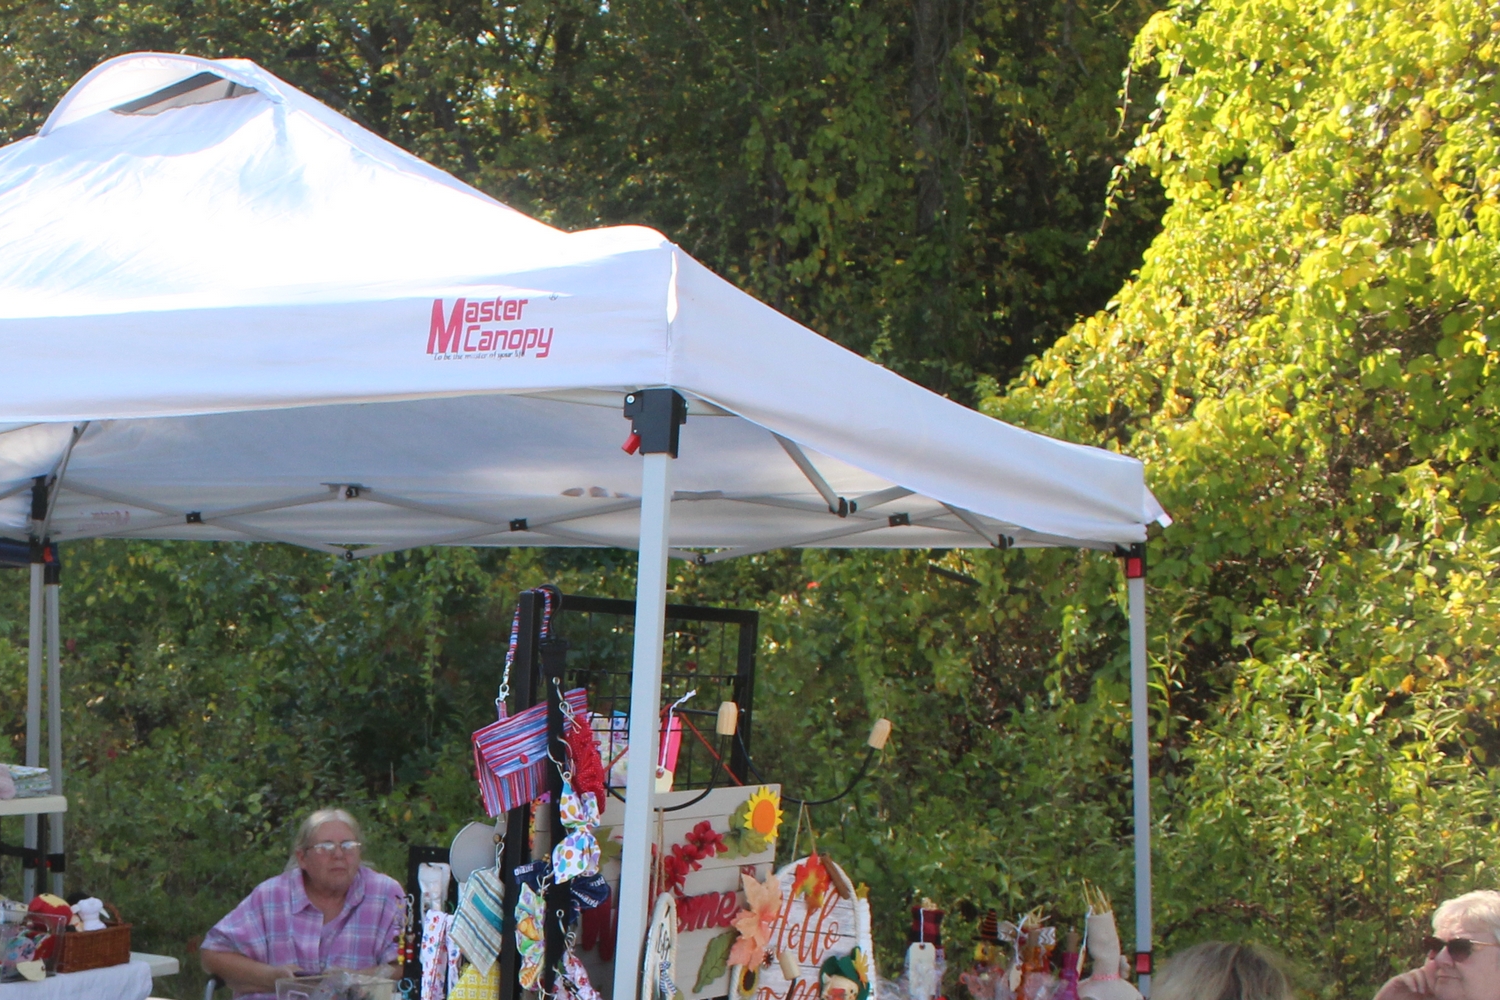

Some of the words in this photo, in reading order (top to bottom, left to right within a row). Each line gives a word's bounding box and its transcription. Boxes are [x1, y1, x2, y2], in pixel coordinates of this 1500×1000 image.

[426, 296, 528, 353] Master
[464, 324, 554, 359] Canopy
[767, 887, 842, 966] Hello
